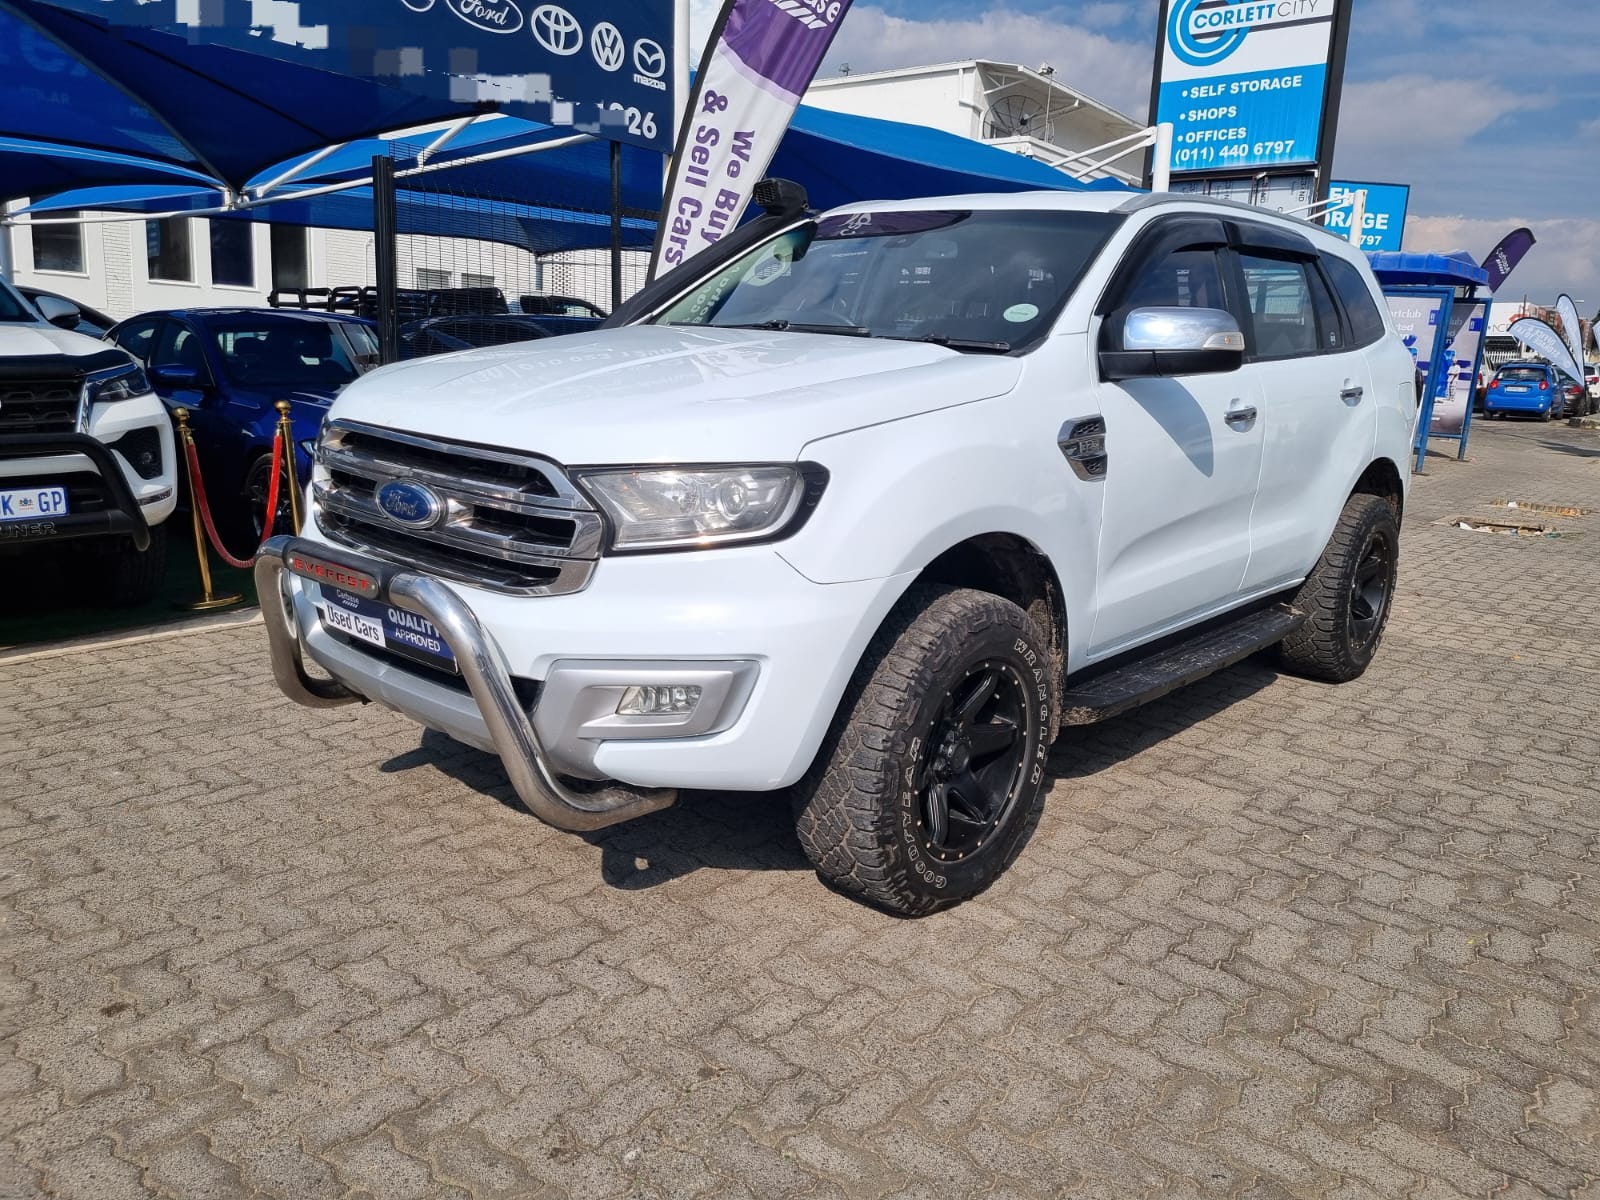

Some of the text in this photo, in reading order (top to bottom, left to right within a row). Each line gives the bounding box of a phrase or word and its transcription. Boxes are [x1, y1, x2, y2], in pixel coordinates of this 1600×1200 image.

[1194, 0, 1318, 29] CORLETT CITY
[633, 73, 666, 91] mazda
[1190, 75, 1303, 99] SELF STORAGE
[1188, 106, 1237, 121] SHOPS
[1185, 127, 1247, 144] OFFICES
[726, 129, 755, 179] We
[1175, 140, 1295, 165] (011) 440 6797
[665, 89, 728, 265] & Sell Cars
[700, 188, 741, 244] Buy
[38, 491, 62, 513] GP
[385, 489, 417, 517] Ford
[294, 558, 370, 592] EVEREST
[327, 605, 380, 641] Used Cars
[388, 608, 440, 639] QUALITY
[395, 628, 441, 652] APPROVED
[1013, 638, 1048, 785] WRANGLER
[902, 736, 948, 889] GOODYEAR
